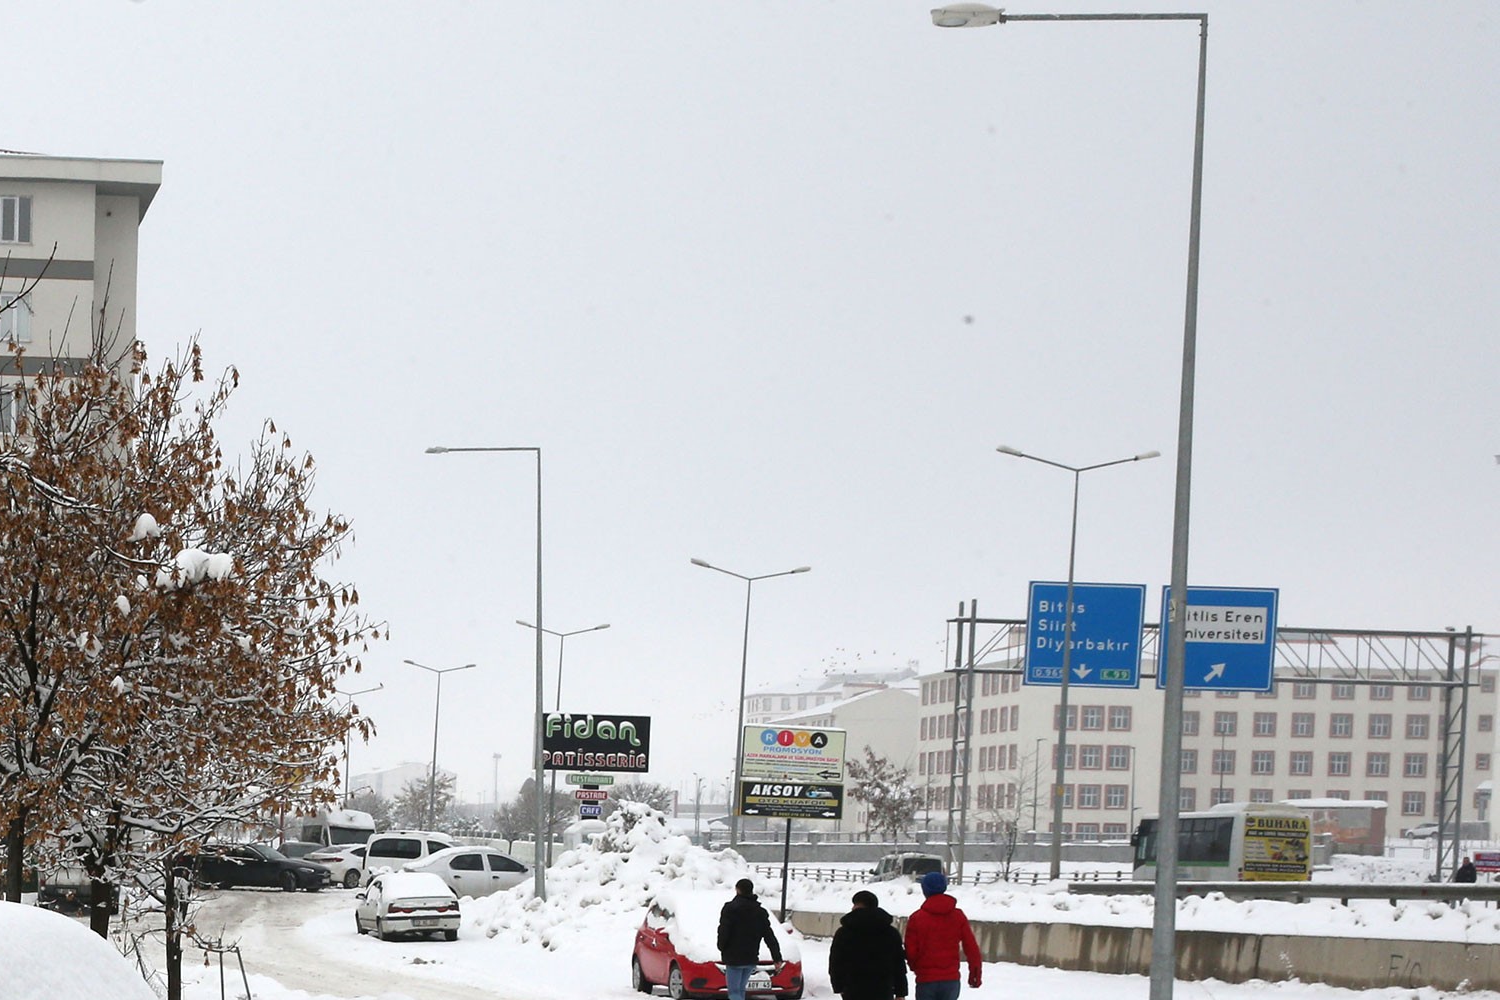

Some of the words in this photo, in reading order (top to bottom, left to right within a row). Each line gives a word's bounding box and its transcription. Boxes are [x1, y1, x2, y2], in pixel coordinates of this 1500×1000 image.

[1186, 610, 1218, 622] itlis
[1225, 611, 1263, 623] Eren
[1038, 619, 1077, 632] Siirt
[1185, 628, 1263, 641] niversitesi
[1036, 636, 1129, 652] Diyarbakır
[546, 713, 641, 747] Fidan
[764, 730, 825, 746] RİVA
[763, 746, 822, 756] PROMOSYON
[576, 791, 607, 799] PASTANE
[750, 784, 804, 797] AKSOY
[581, 806, 600, 815] CAFE
[1258, 818, 1307, 829] BUHARA
